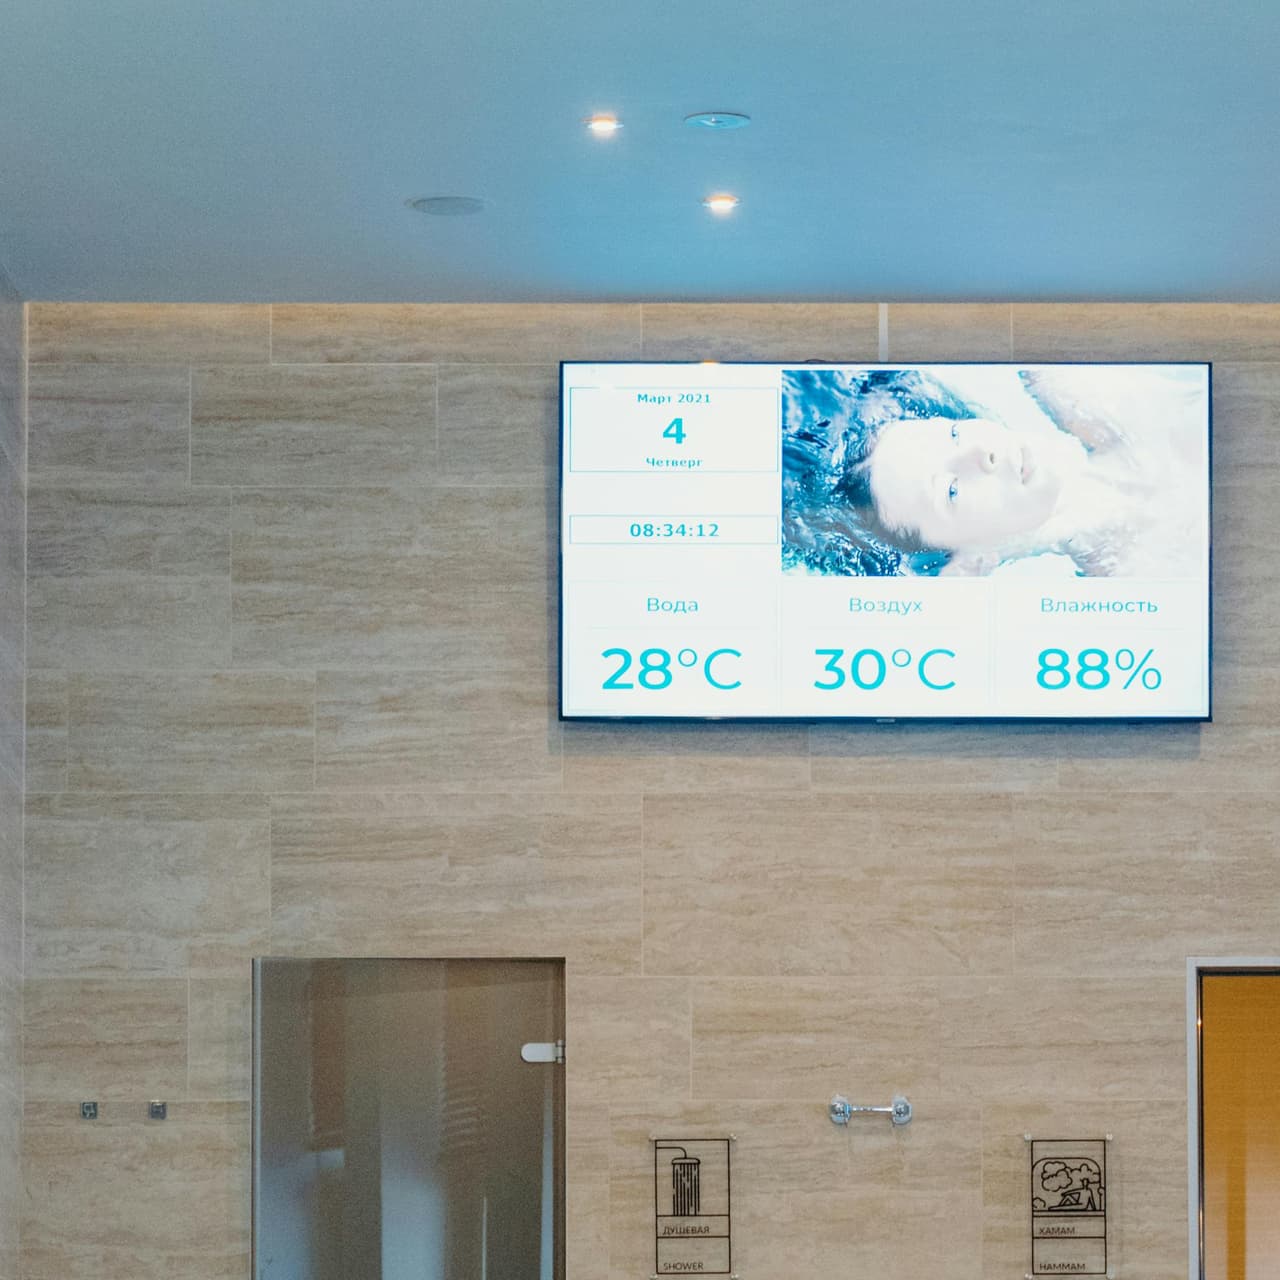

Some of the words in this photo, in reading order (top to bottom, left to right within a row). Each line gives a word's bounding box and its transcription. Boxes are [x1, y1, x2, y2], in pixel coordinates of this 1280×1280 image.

[637, 393, 672, 405] Март
[677, 393, 710, 403] 2021
[662, 417, 687, 445] 4
[646, 457, 703, 469] Четверг
[629, 523, 719, 538] 08:34:12
[646, 597, 699, 615] Вода
[848, 597, 923, 616] Воздух
[1040, 597, 1158, 614] Влажность
[600, 647, 743, 691] 28°C
[813, 647, 957, 691] 30°C
[1036, 647, 1163, 691] 88%
[662, 1226, 710, 1235] ДУШЕВАЯ
[1039, 1226, 1076, 1235] ХАМАМ
[663, 1262, 704, 1271] SHOWER
[1039, 1262, 1086, 1271] HAMMAM
